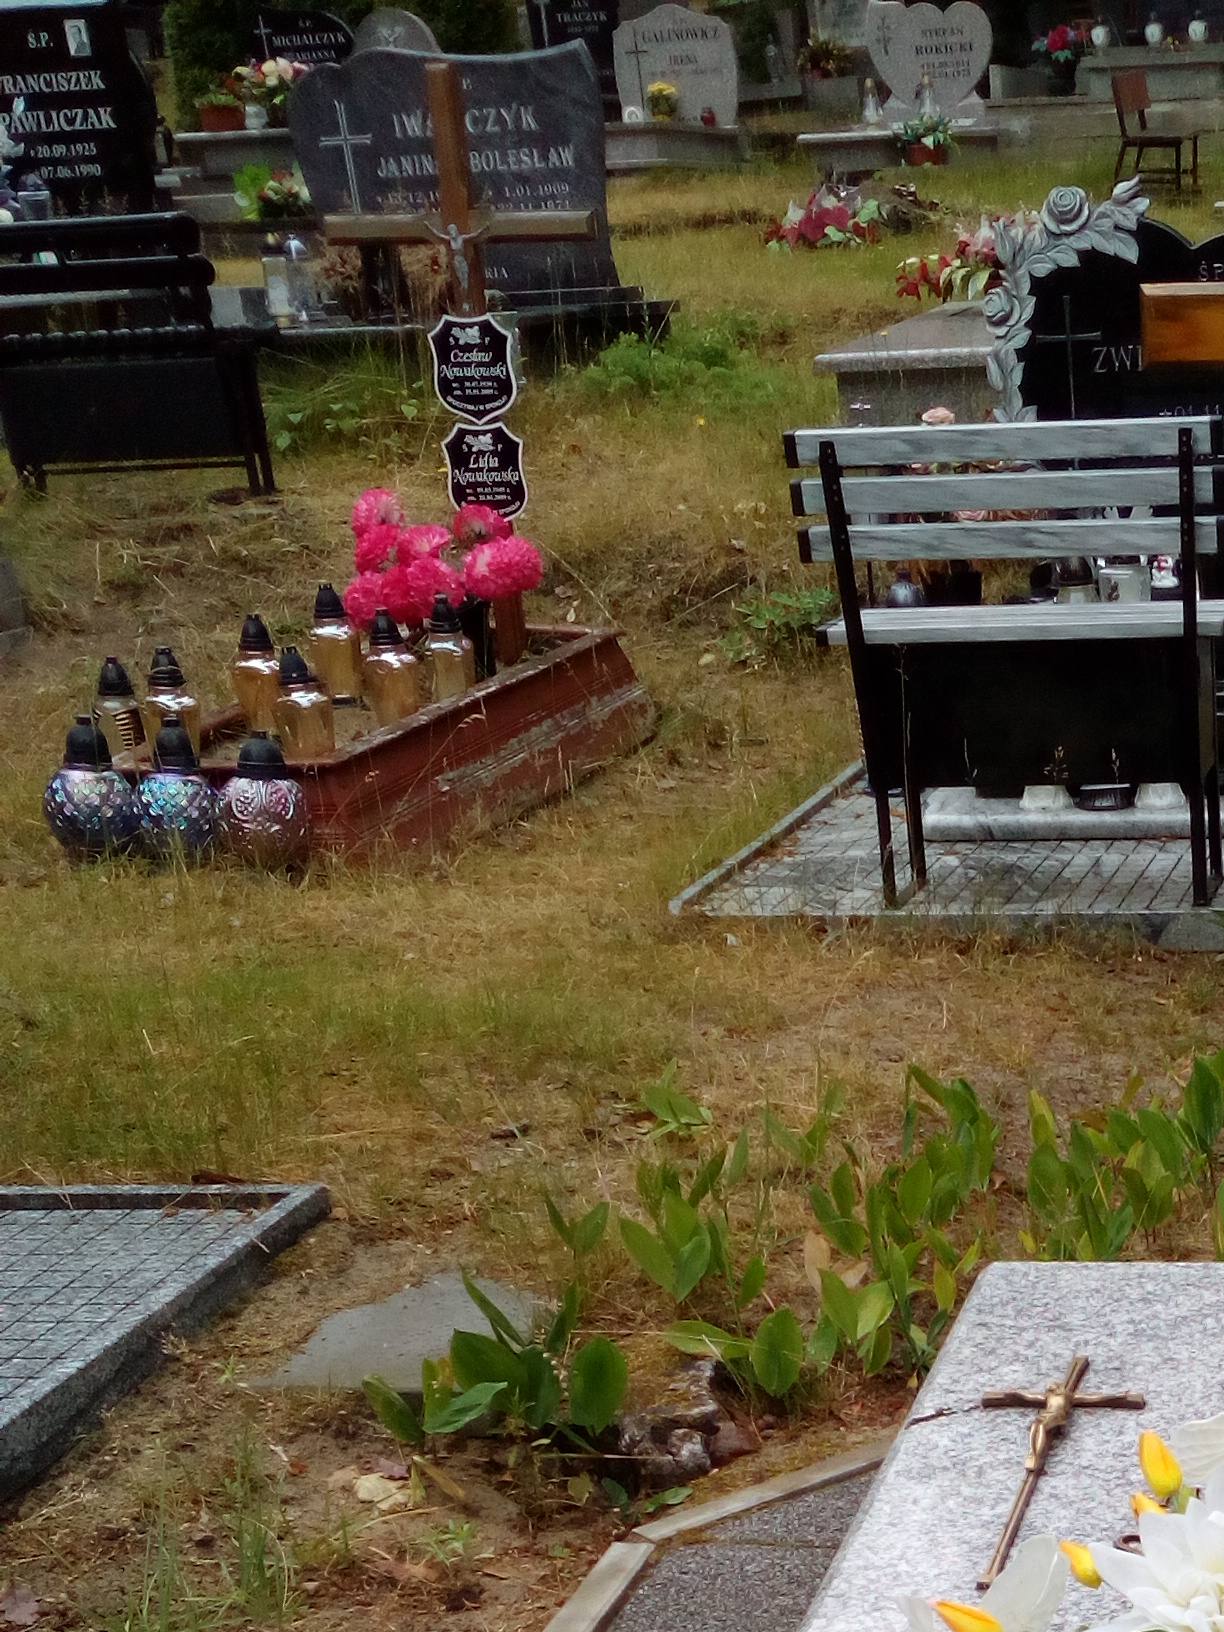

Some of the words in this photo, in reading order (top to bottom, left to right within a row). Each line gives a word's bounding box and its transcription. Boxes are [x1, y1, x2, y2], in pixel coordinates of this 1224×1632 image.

[915, 41, 973, 55] ROKICKI
[0, 70, 106, 94] RANCISZEK
[377, 154, 438, 178] JANIN
[440, 362, 507, 380] Nowakowski
[453, 466, 519, 485] Nowakowska
